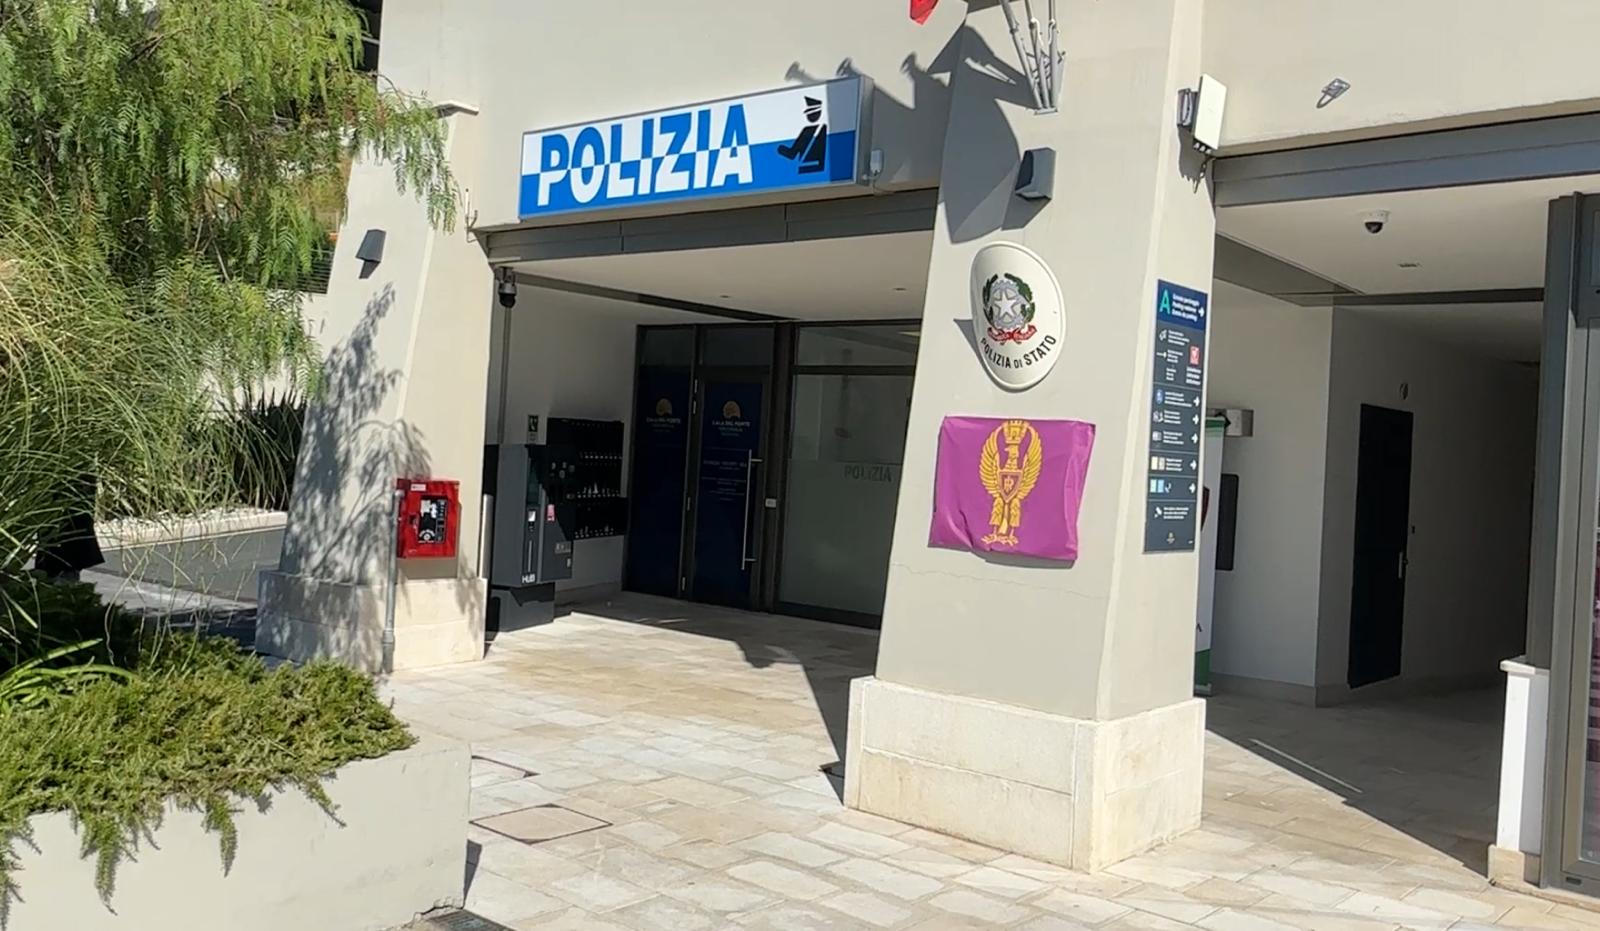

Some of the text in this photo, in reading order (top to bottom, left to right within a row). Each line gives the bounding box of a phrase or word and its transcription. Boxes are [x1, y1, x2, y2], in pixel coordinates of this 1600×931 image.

[537, 104, 753, 206] POLIZIA
[1159, 289, 1170, 314] A
[981, 337, 1011, 368] POLIZIA
[1023, 335, 1056, 366] STATO
[844, 464, 892, 482] POLIZIA
